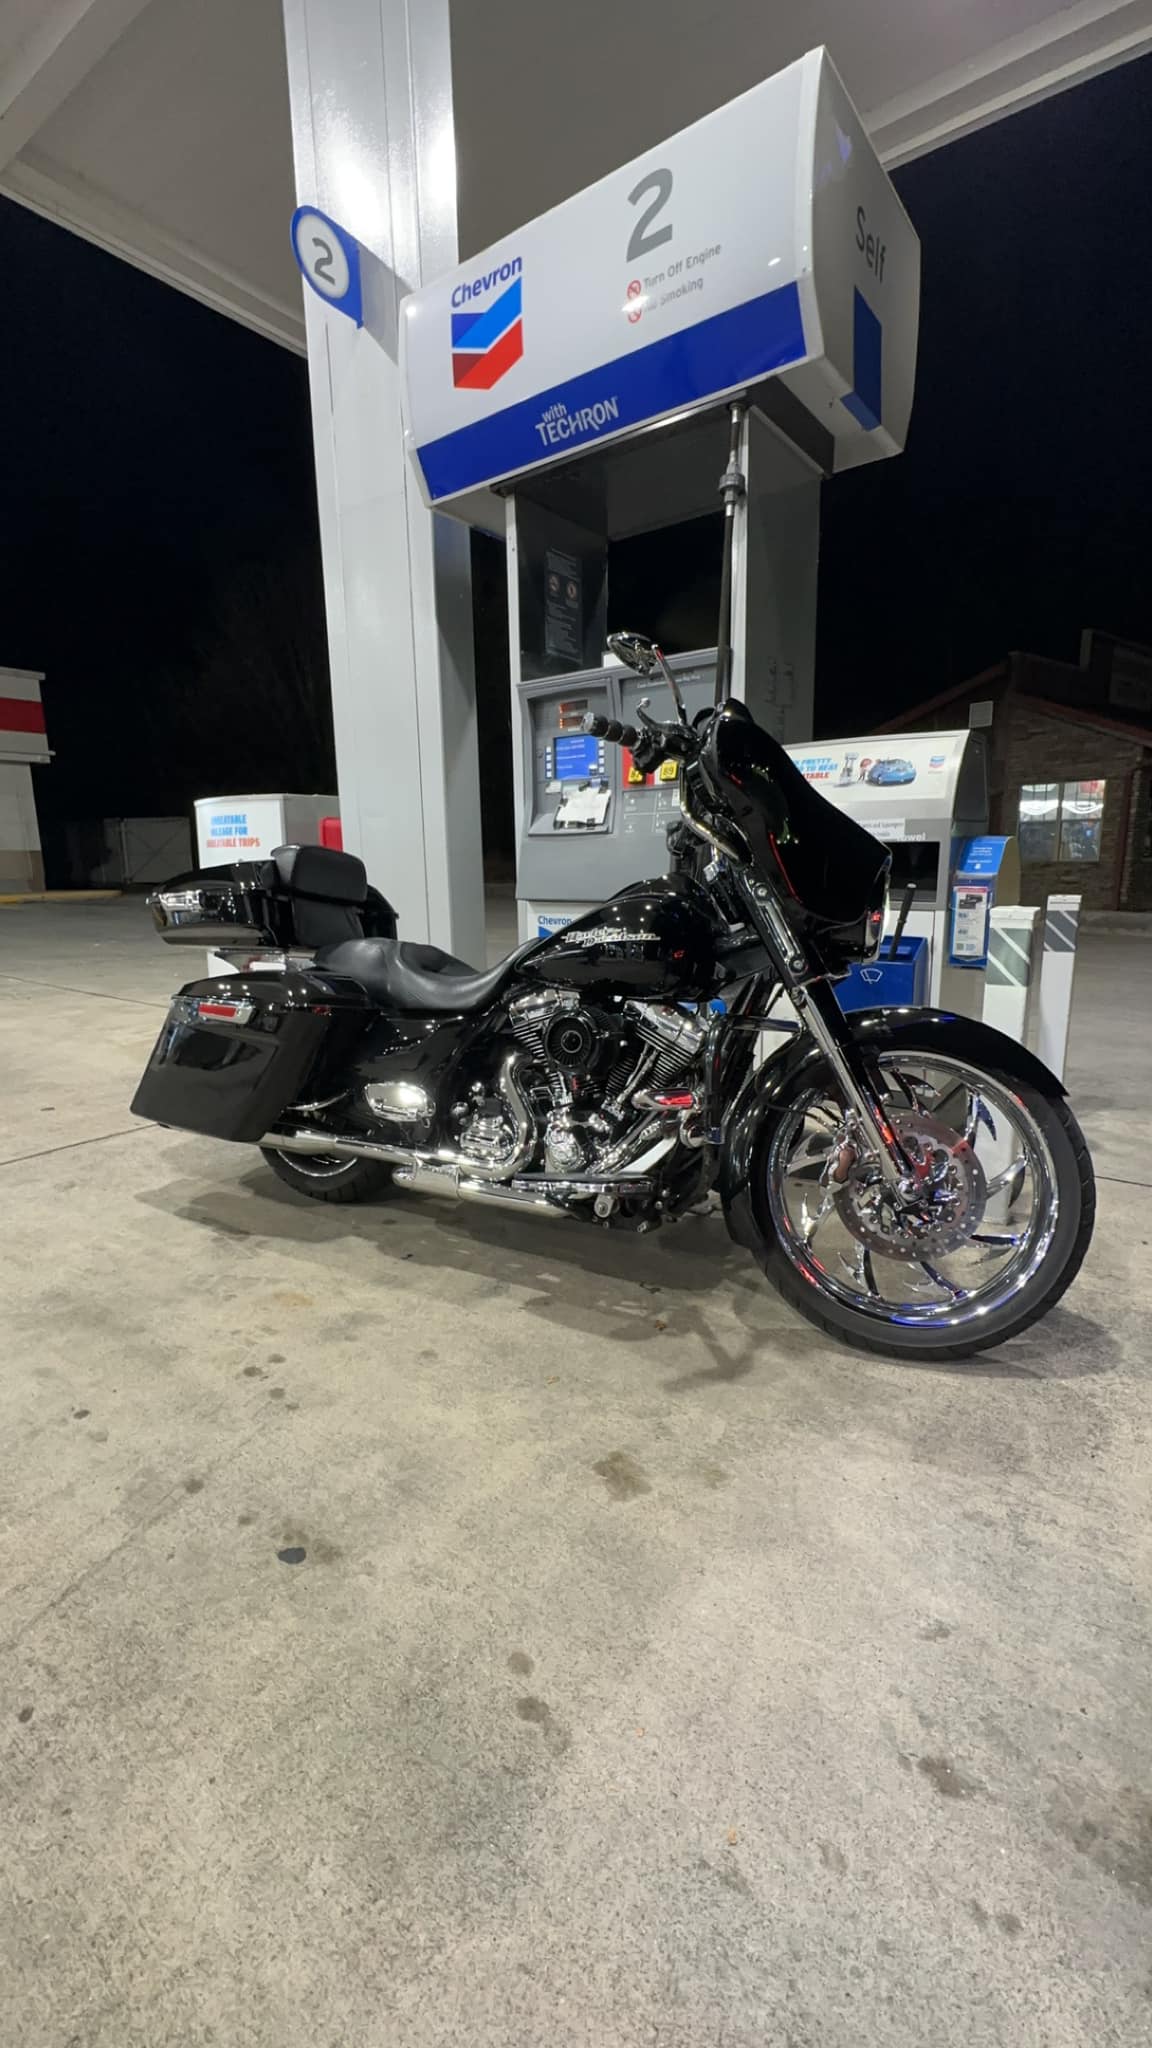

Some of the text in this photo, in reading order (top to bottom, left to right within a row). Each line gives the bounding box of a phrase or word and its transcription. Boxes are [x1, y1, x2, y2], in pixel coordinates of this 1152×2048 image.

[626, 168, 673, 263] 2
[312, 237, 336, 286] 2
[643, 244, 722, 289] Turn Off Engine
[856, 205, 886, 284] Self
[451, 256, 522, 309] Chevron
[660, 278, 704, 306] Smoking
[535, 397, 619, 446] TECHRON
[541, 402, 567, 423] with
